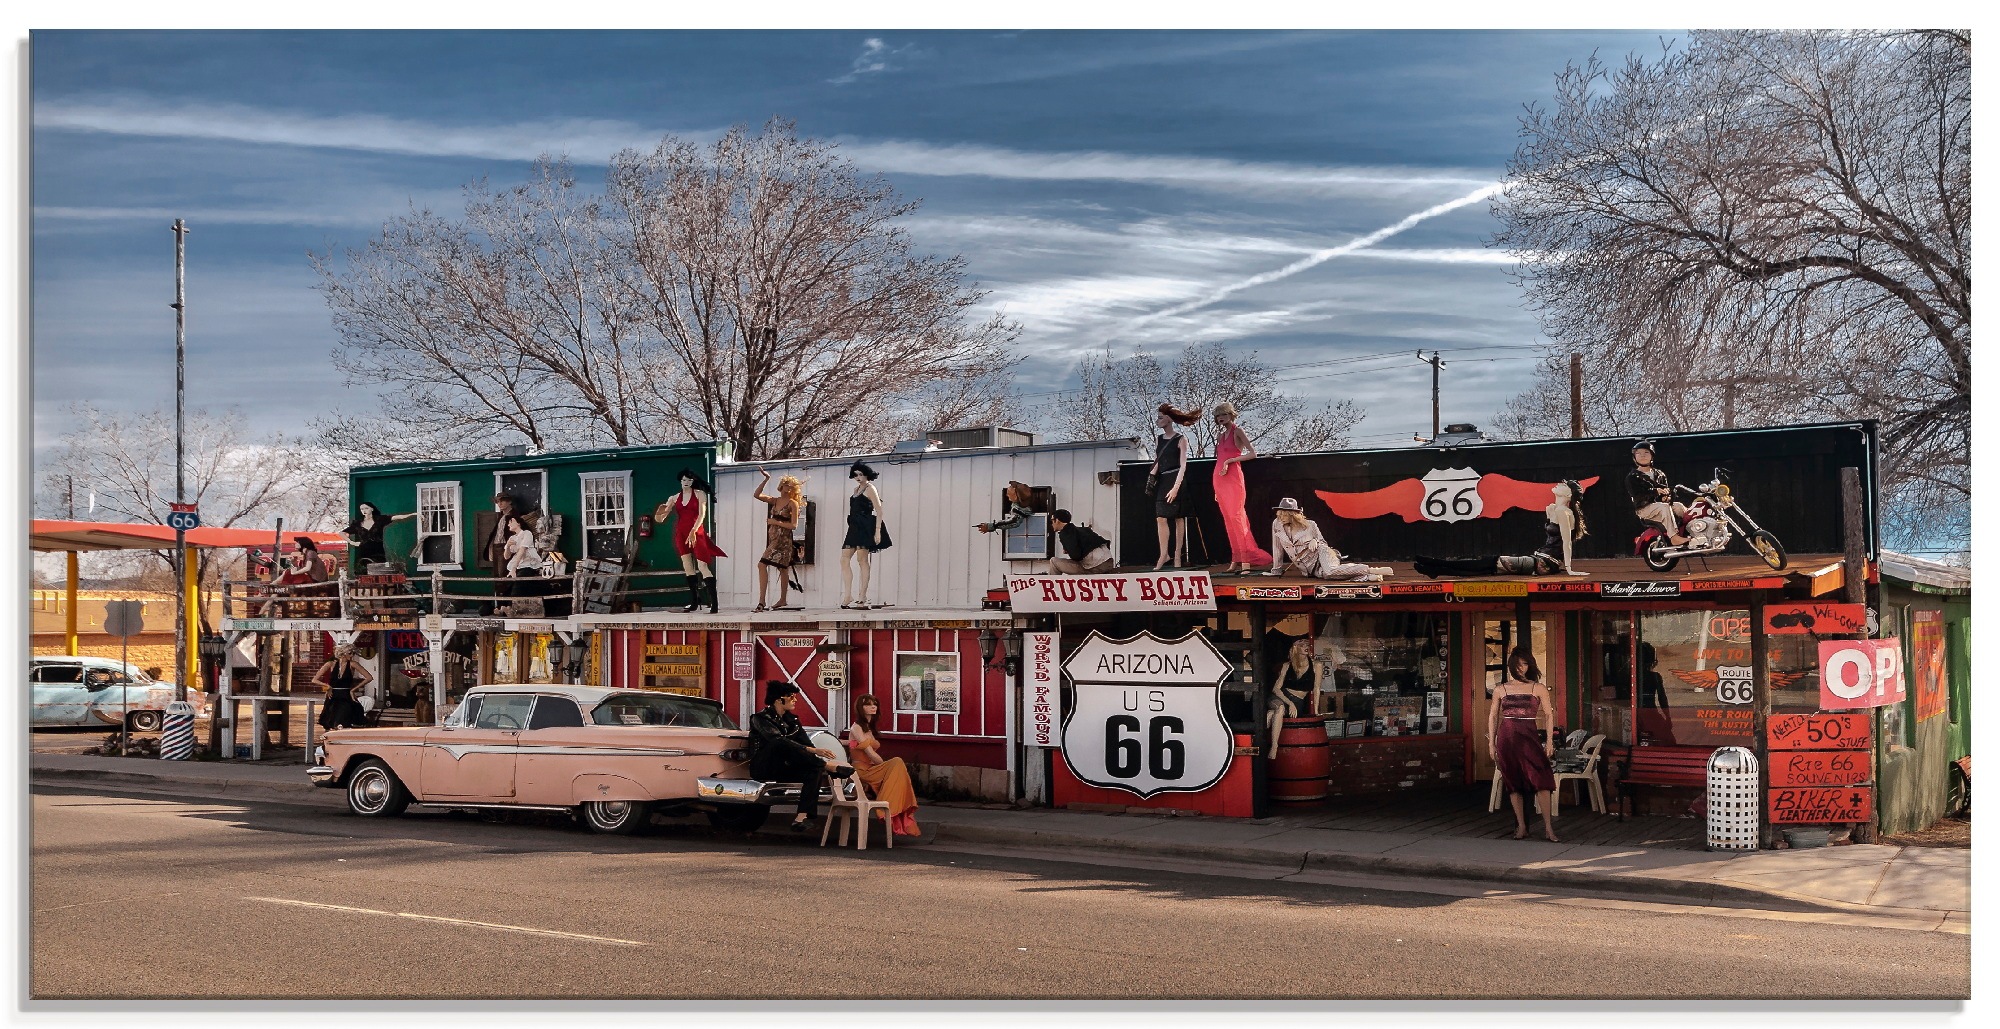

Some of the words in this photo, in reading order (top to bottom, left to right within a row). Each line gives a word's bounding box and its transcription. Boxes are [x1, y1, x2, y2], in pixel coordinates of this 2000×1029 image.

[1426, 487, 1475, 517] 66
[172, 514, 195, 528] 66
[1011, 577, 1036, 593] The
[1039, 578, 1127, 602] RUSTY
[1136, 576, 1209, 601] BOLT
[1608, 583, 1642, 596] Marilyn
[1643, 582, 1677, 593] Monroe
[1813, 605, 1865, 633] WELCOME
[390, 632, 425, 648] OPEN
[650, 645, 668, 655] LEMON
[671, 645, 682, 655] CAB
[685, 645, 694, 655] CO
[1033, 635, 1052, 682] WORLD
[1693, 649, 1722, 660] LIVE
[1727, 649, 1744, 659] TO
[1096, 654, 1195, 675] ARIZONA
[823, 677, 842, 686] 66
[1720, 681, 1753, 701] 66
[1033, 686, 1052, 745] FAMOUS
[1697, 710, 1722, 718] RIDE
[1772, 715, 1805, 740] NEATO
[1105, 714, 1185, 780] 66
[1836, 737, 1868, 747] STUFF
[1789, 755, 1823, 771] Rte
[1831, 754, 1854, 770] 66
[1787, 772, 1866, 784] SOUVENIRS
[1774, 789, 1843, 811] BIKER
